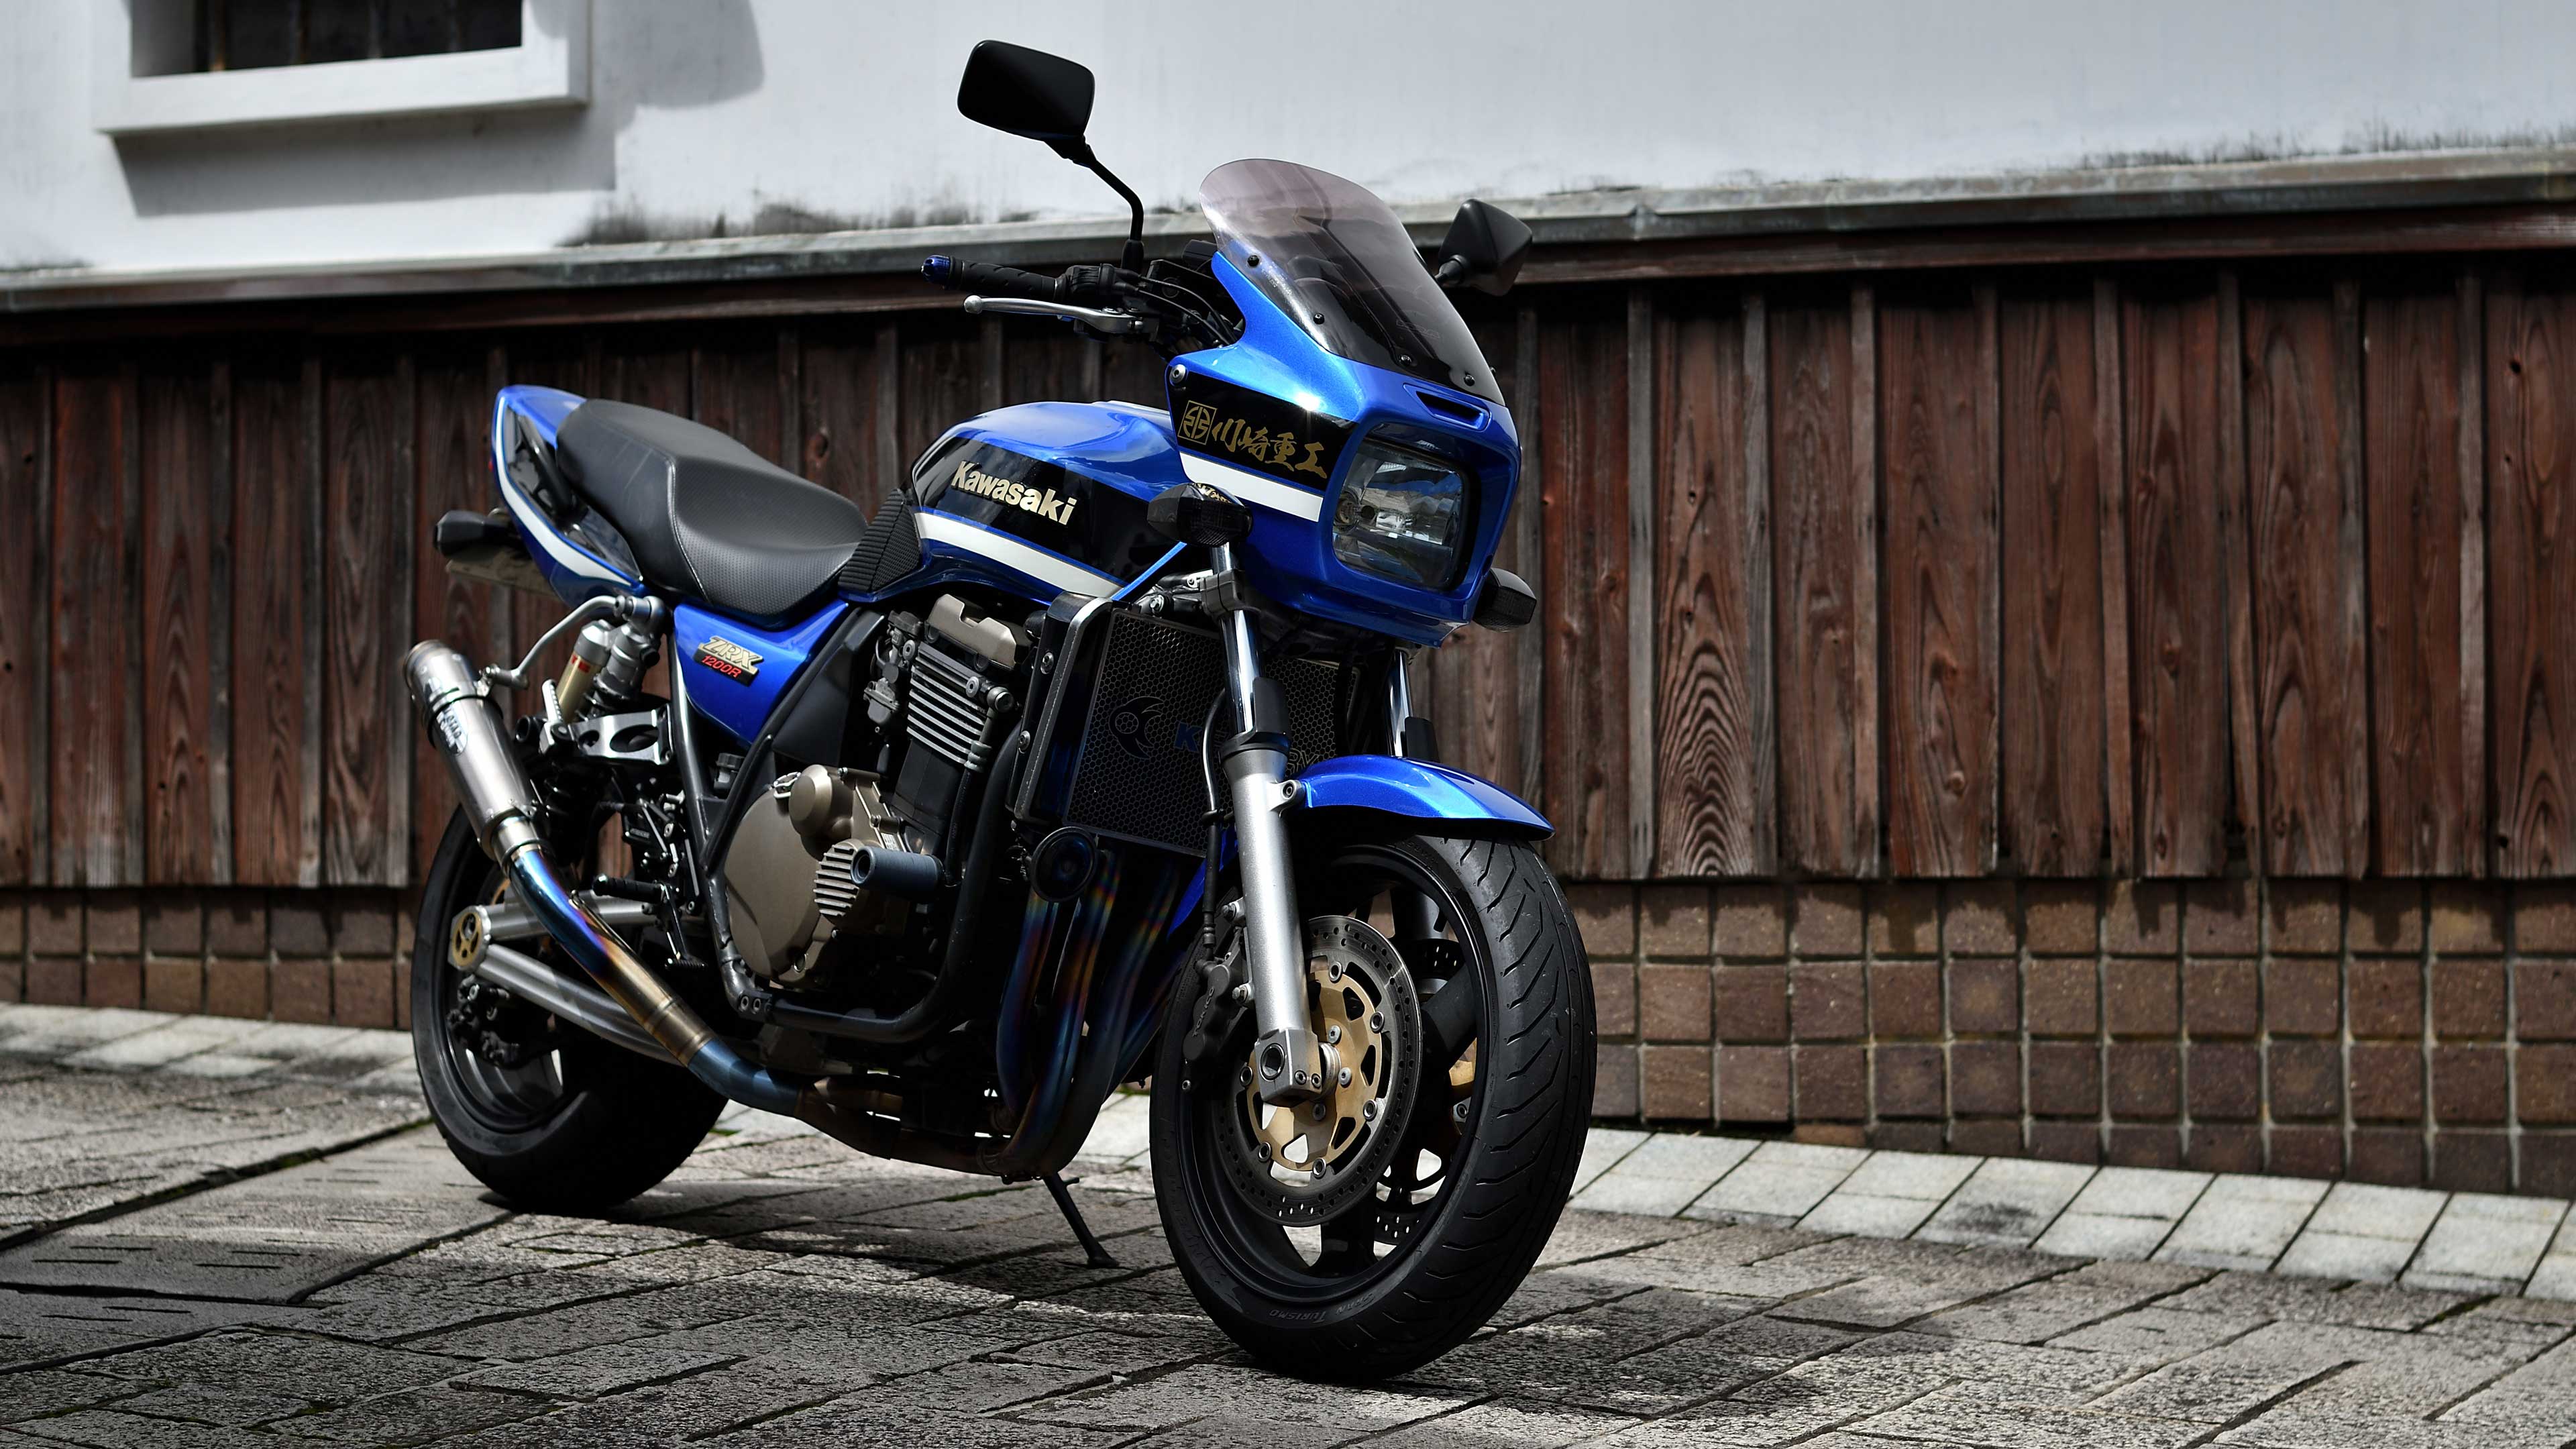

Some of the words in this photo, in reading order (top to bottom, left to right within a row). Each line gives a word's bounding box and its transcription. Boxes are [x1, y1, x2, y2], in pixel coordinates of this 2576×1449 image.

[1212, 418, 1328, 479] 川崎重工
[951, 460, 1077, 526] Kawasaki
[701, 655, 742, 678] 1200R
[702, 636, 759, 670] ZRX
